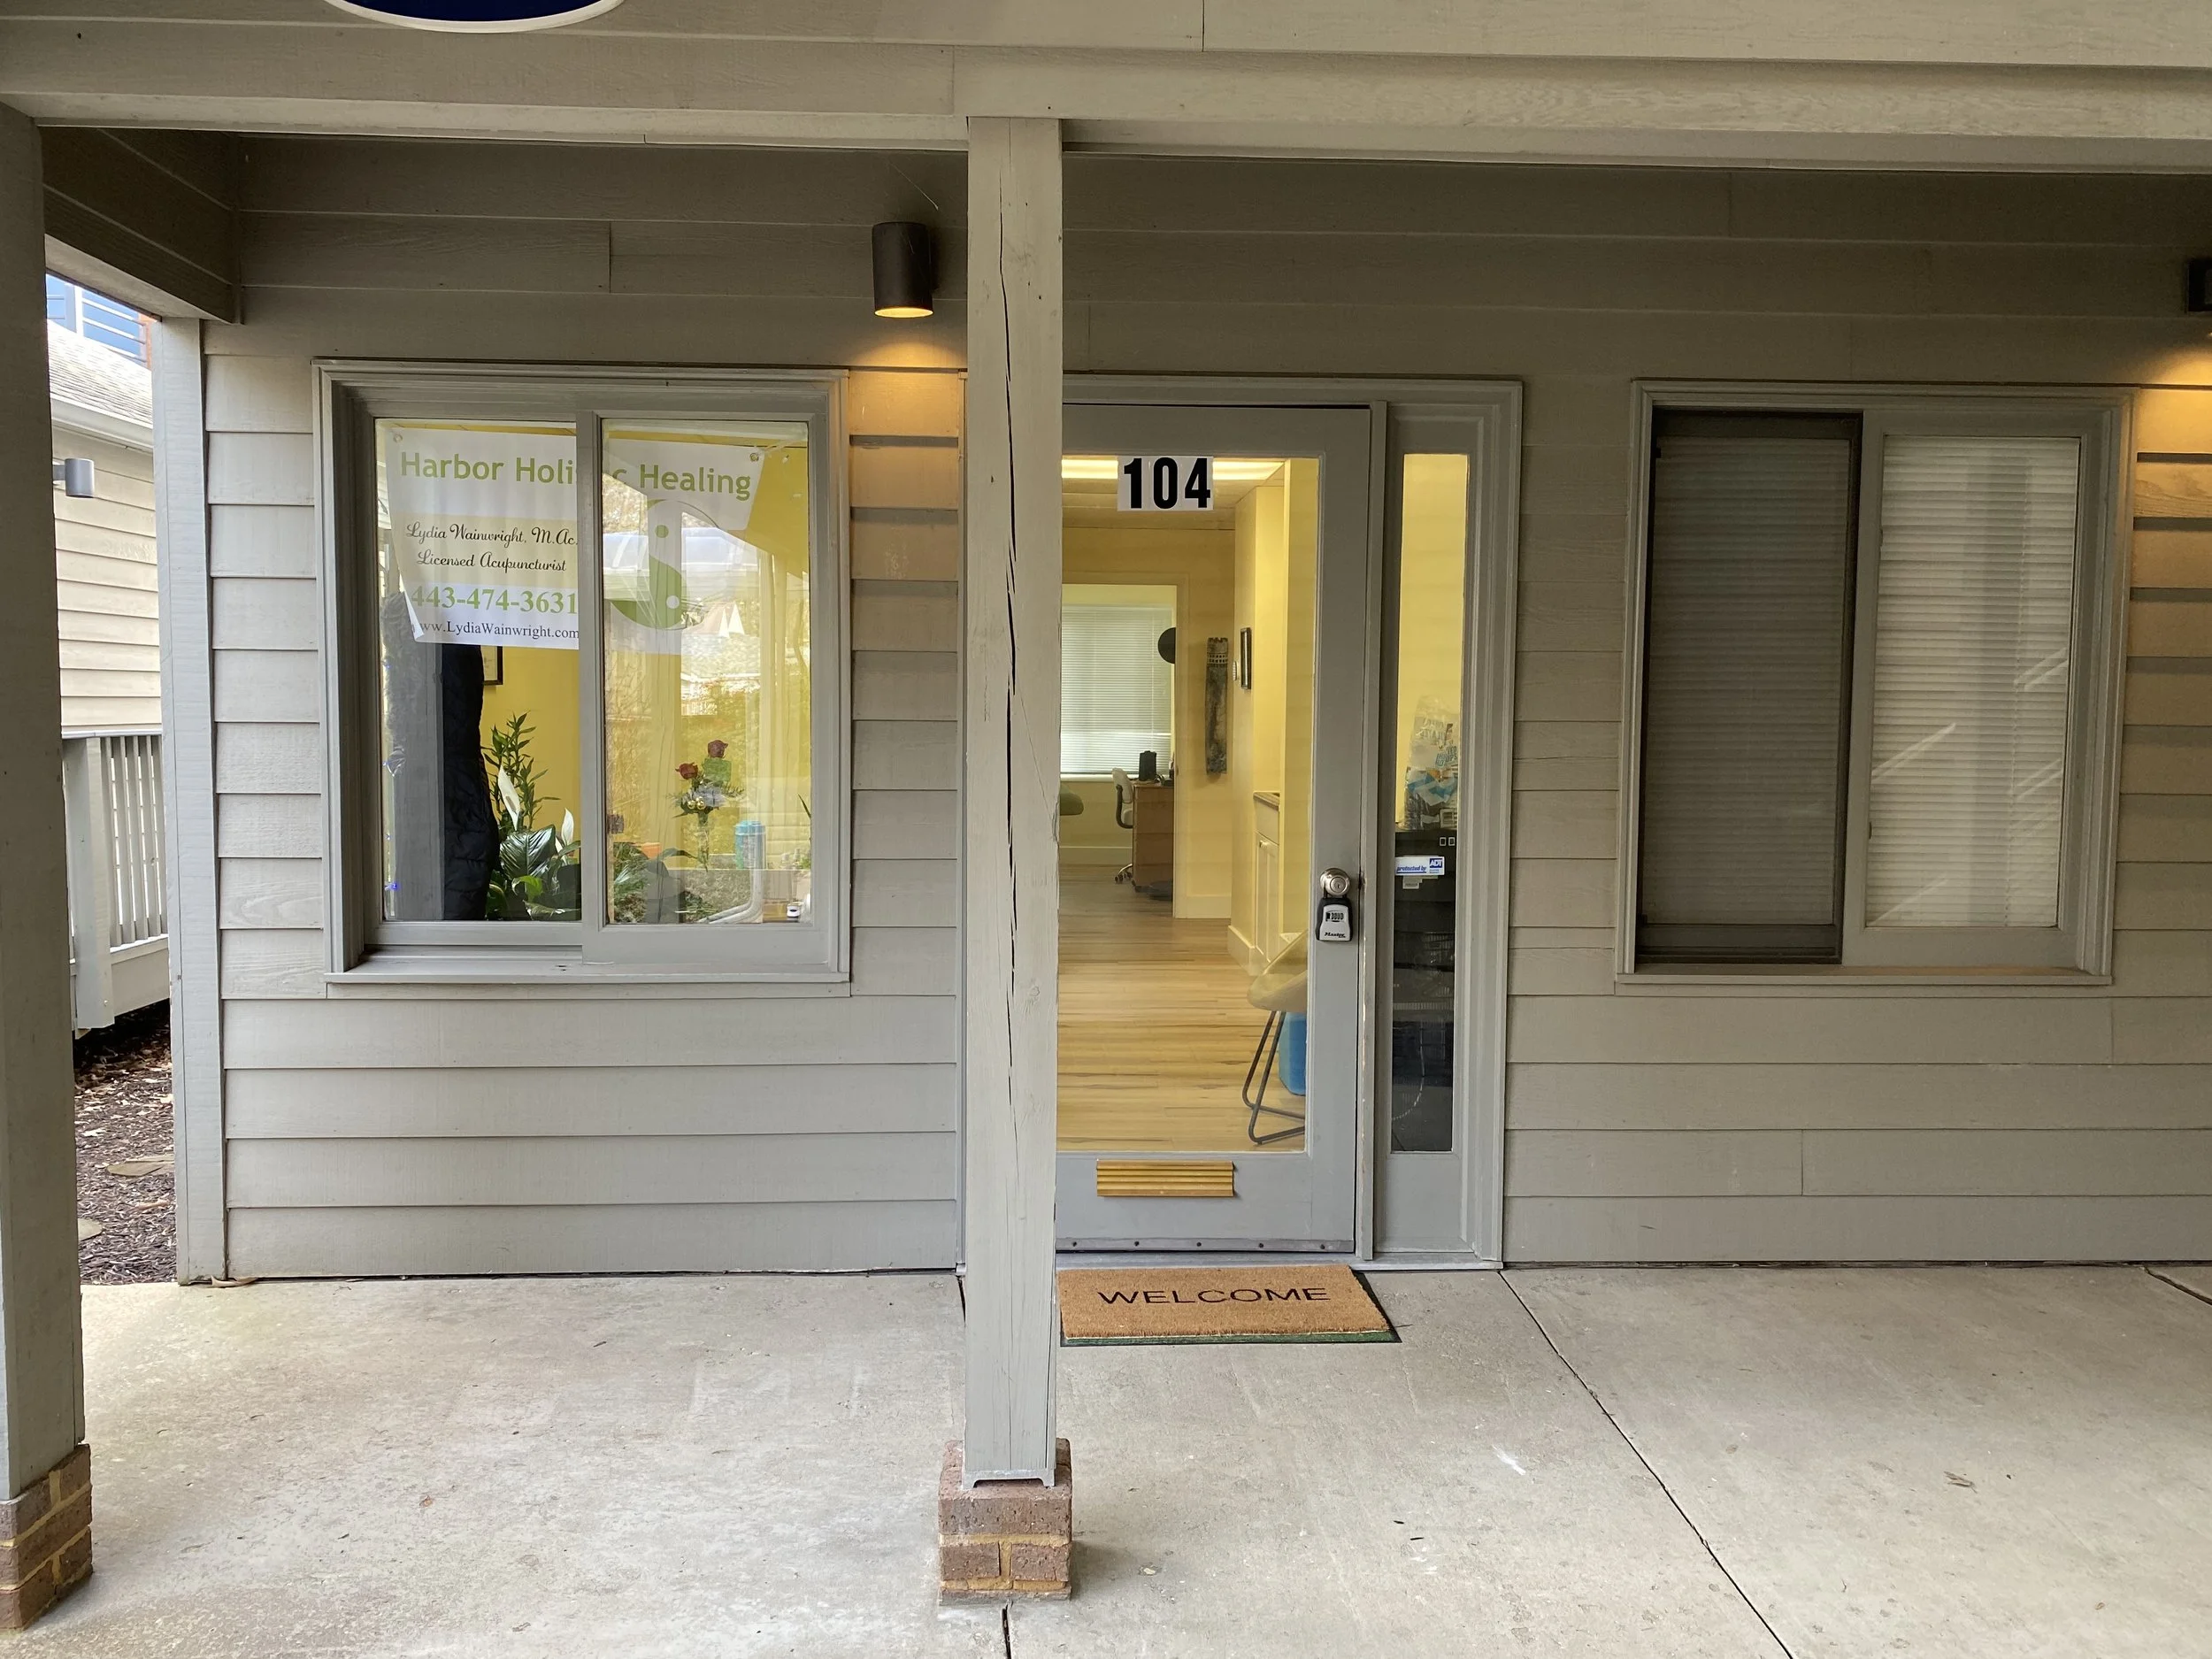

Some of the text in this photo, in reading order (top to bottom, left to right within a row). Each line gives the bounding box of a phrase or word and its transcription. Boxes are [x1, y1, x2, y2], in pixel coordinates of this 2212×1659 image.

[401, 451, 503, 480] Harbor
[640, 464, 751, 502] Healing
[1124, 457, 1211, 510] 104
[406, 521, 447, 545] Lydia
[417, 549, 567, 573] Licensed Acupuncturist
[411, 586, 578, 615] 443-474-3631
[419, 620, 580, 640] ww.LydiaWainwright.com
[1097, 1287, 1332, 1304] WELCOME
